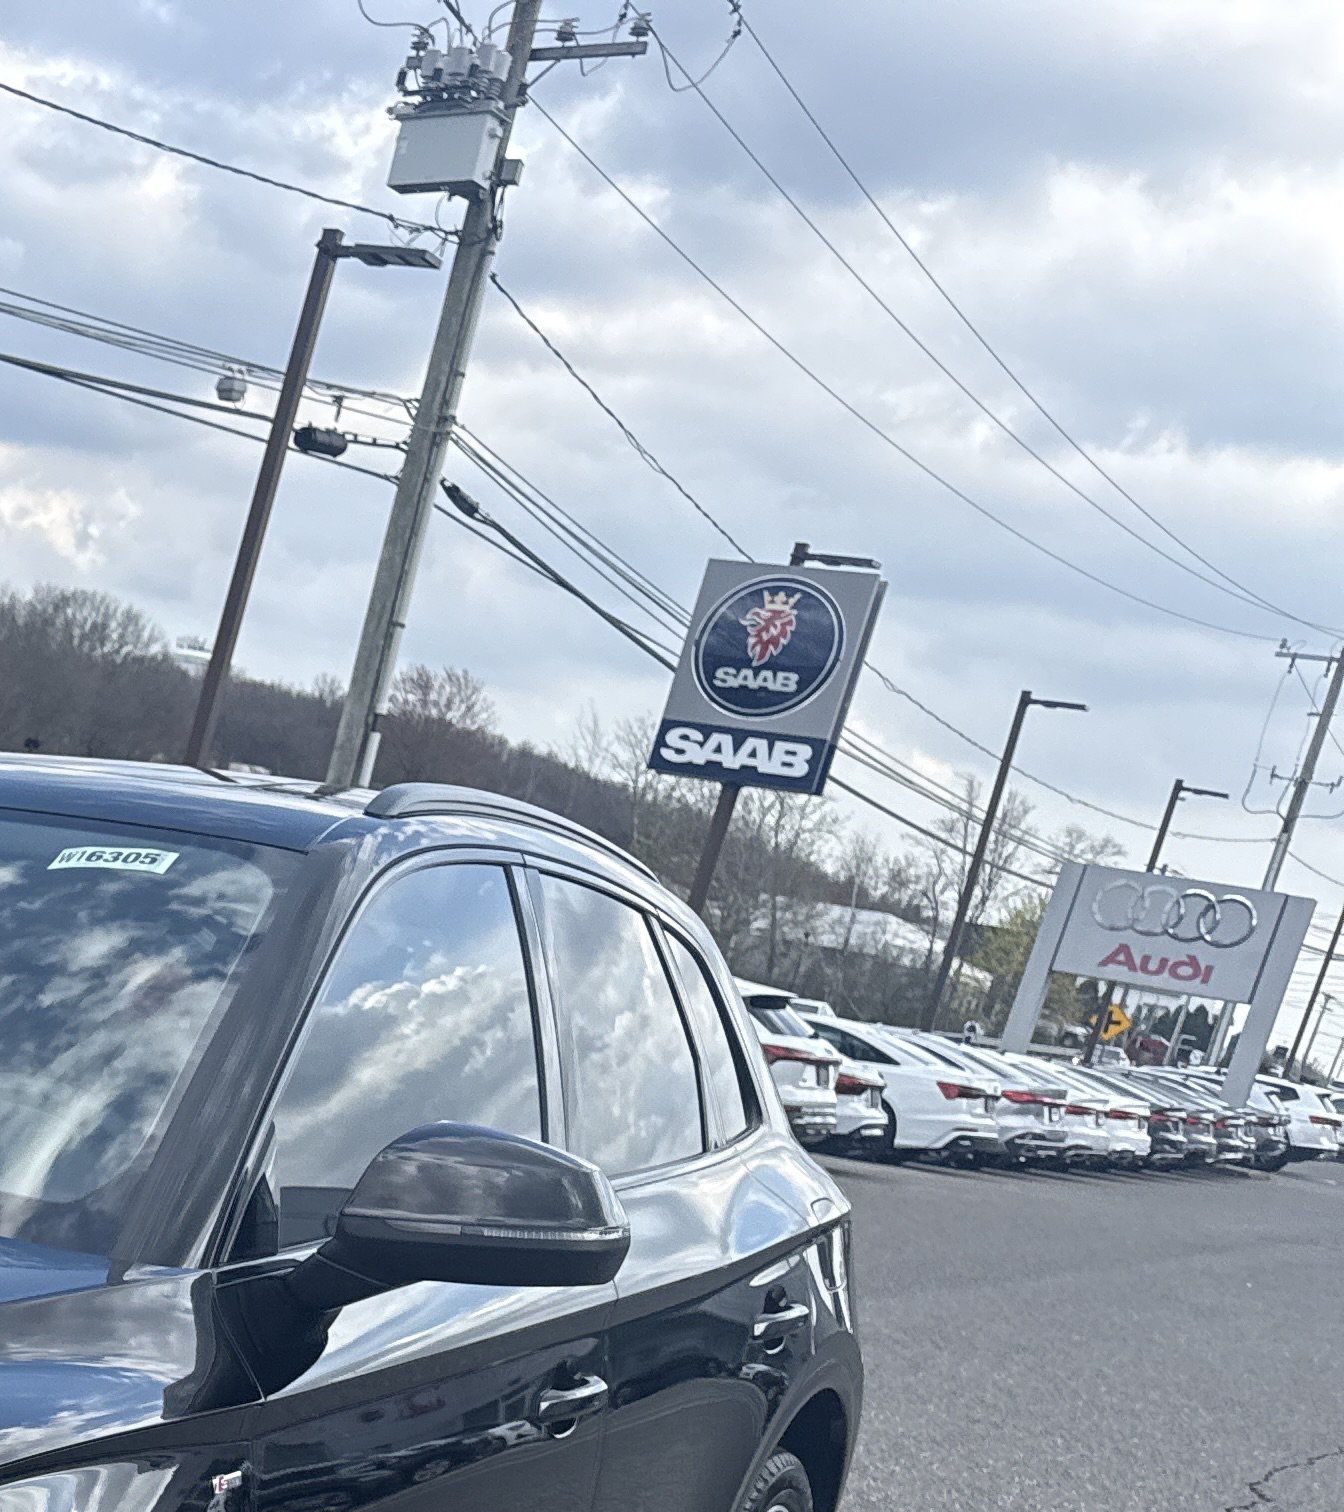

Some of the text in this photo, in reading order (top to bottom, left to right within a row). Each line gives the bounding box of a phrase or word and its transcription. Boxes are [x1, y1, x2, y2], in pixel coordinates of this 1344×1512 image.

[713, 666, 800, 692] SAAB
[660, 727, 814, 778] SAAB
[58, 850, 161, 865] W16305
[1098, 943, 1214, 984] Audi
